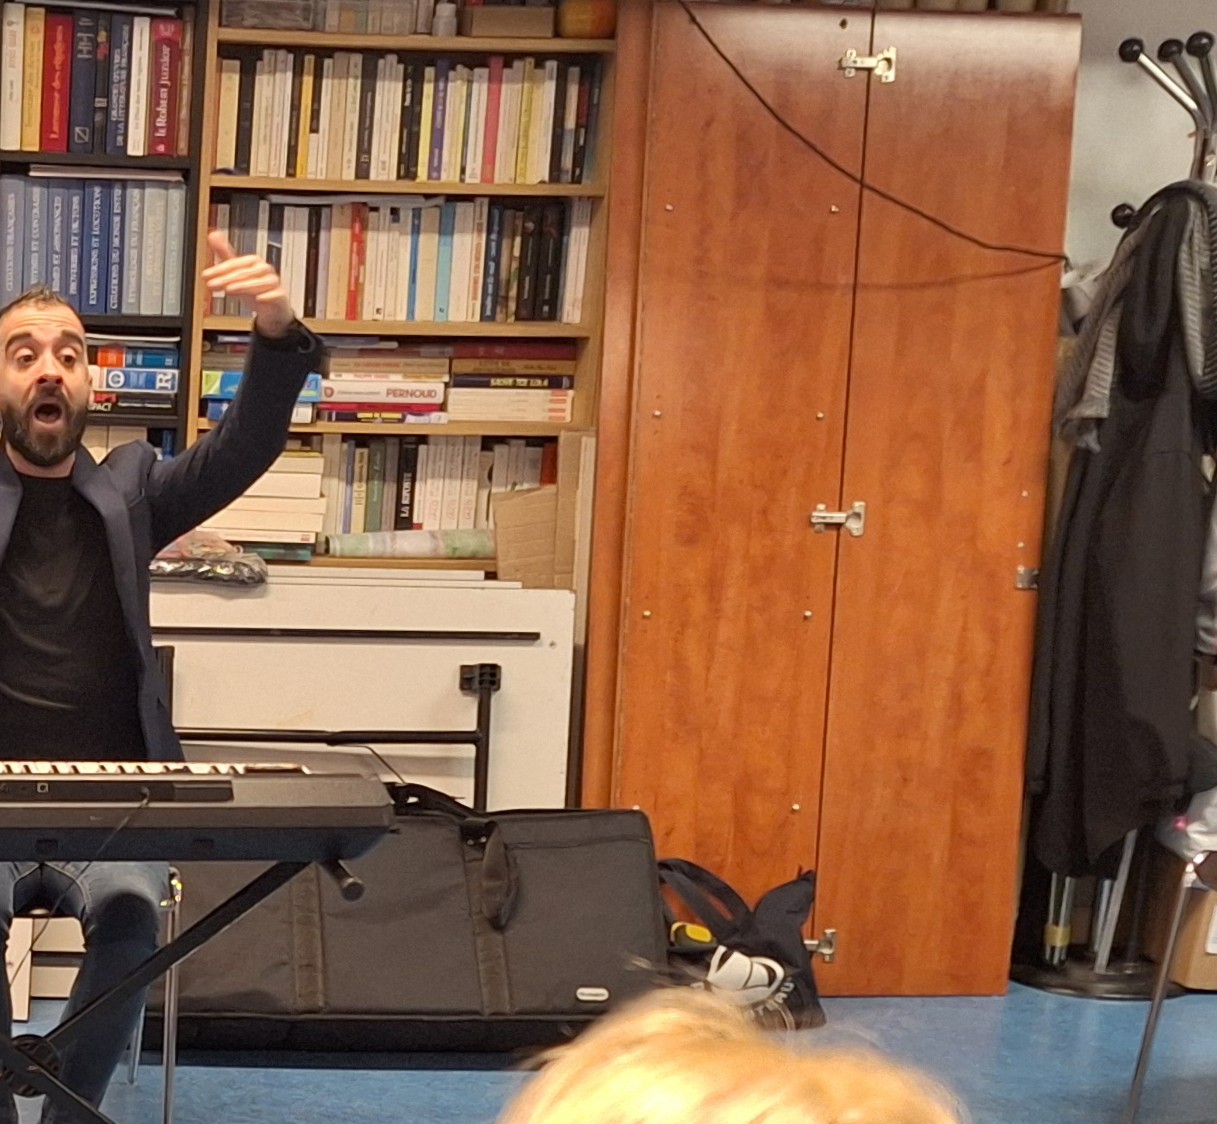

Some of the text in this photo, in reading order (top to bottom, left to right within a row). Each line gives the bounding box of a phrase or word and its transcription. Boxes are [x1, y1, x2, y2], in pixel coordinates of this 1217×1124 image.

[157, 44, 172, 86] junior
[155, 87, 168, 126] Robert
[386, 388, 437, 399] PERNOUD
[400, 505, 411, 518] LA
